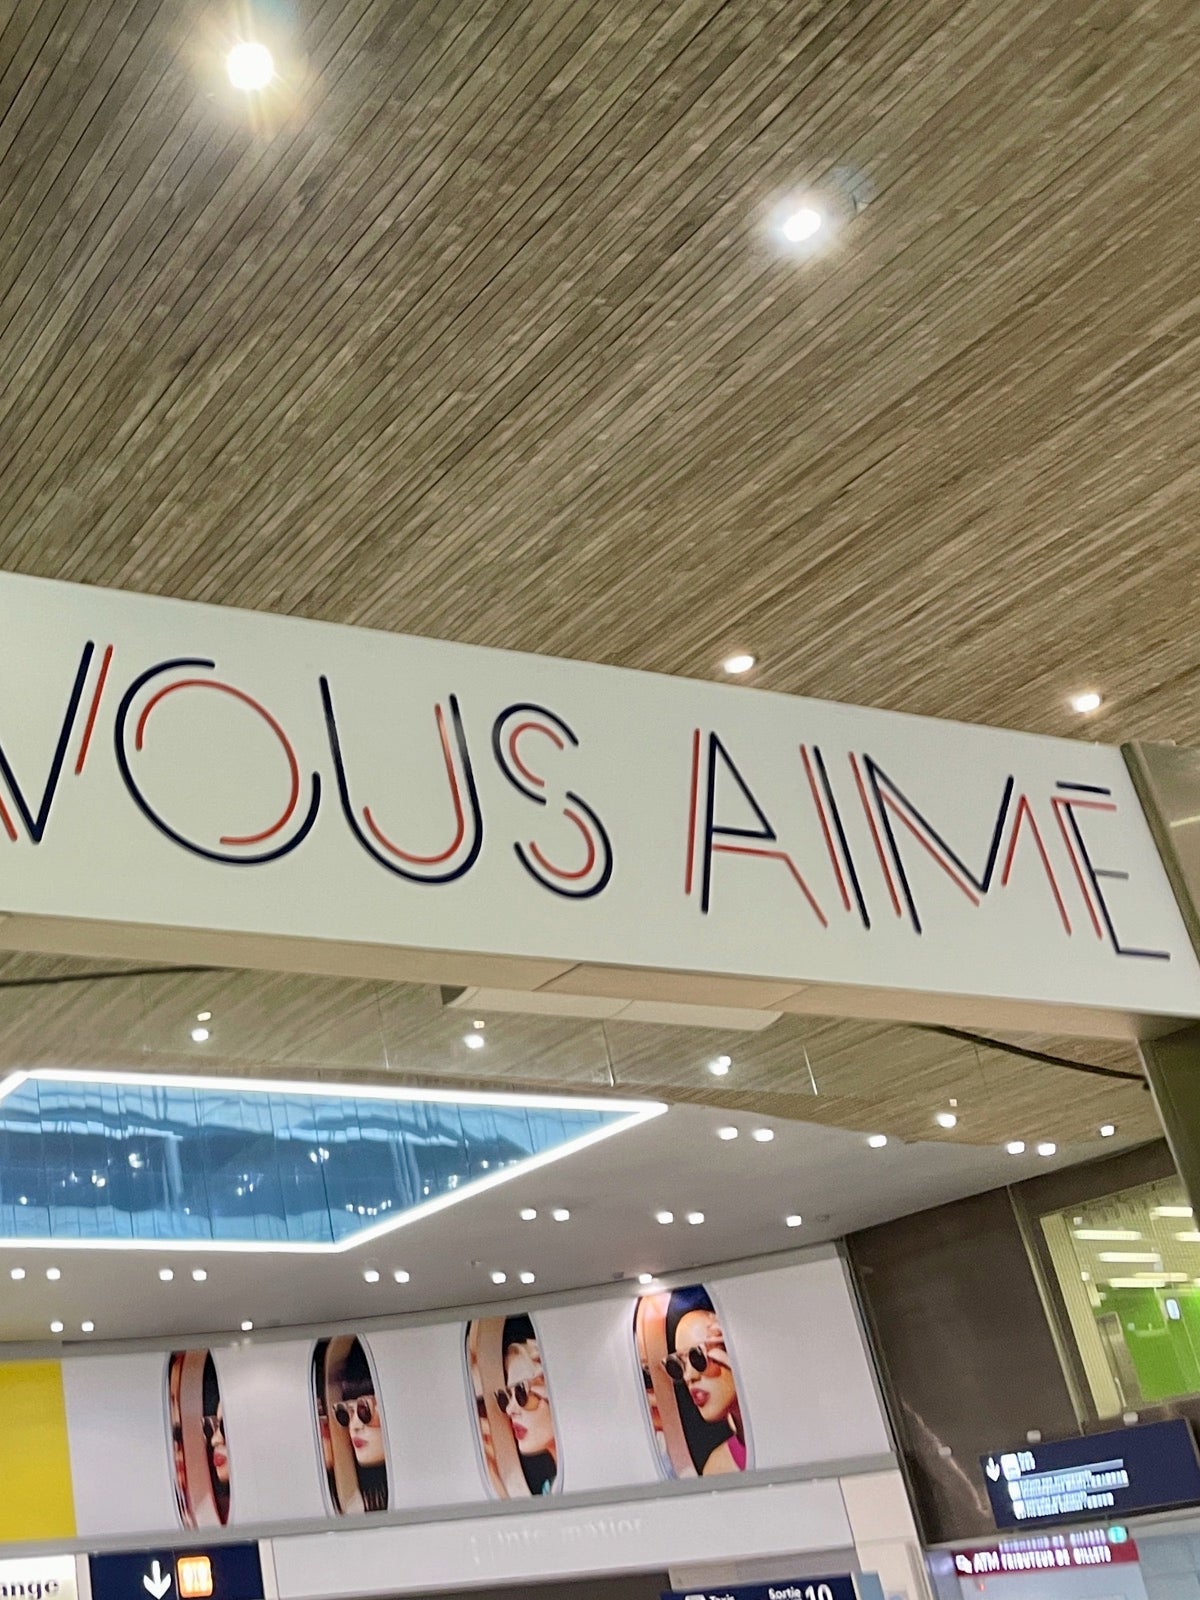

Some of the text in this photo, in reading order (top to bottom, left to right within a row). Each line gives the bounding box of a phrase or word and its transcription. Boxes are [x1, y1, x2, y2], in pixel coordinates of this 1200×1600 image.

[685, 727, 1170, 960] AIME
[973, 1551, 1000, 1573] ATM
[768, 1586, 801, 1600] Sortie
